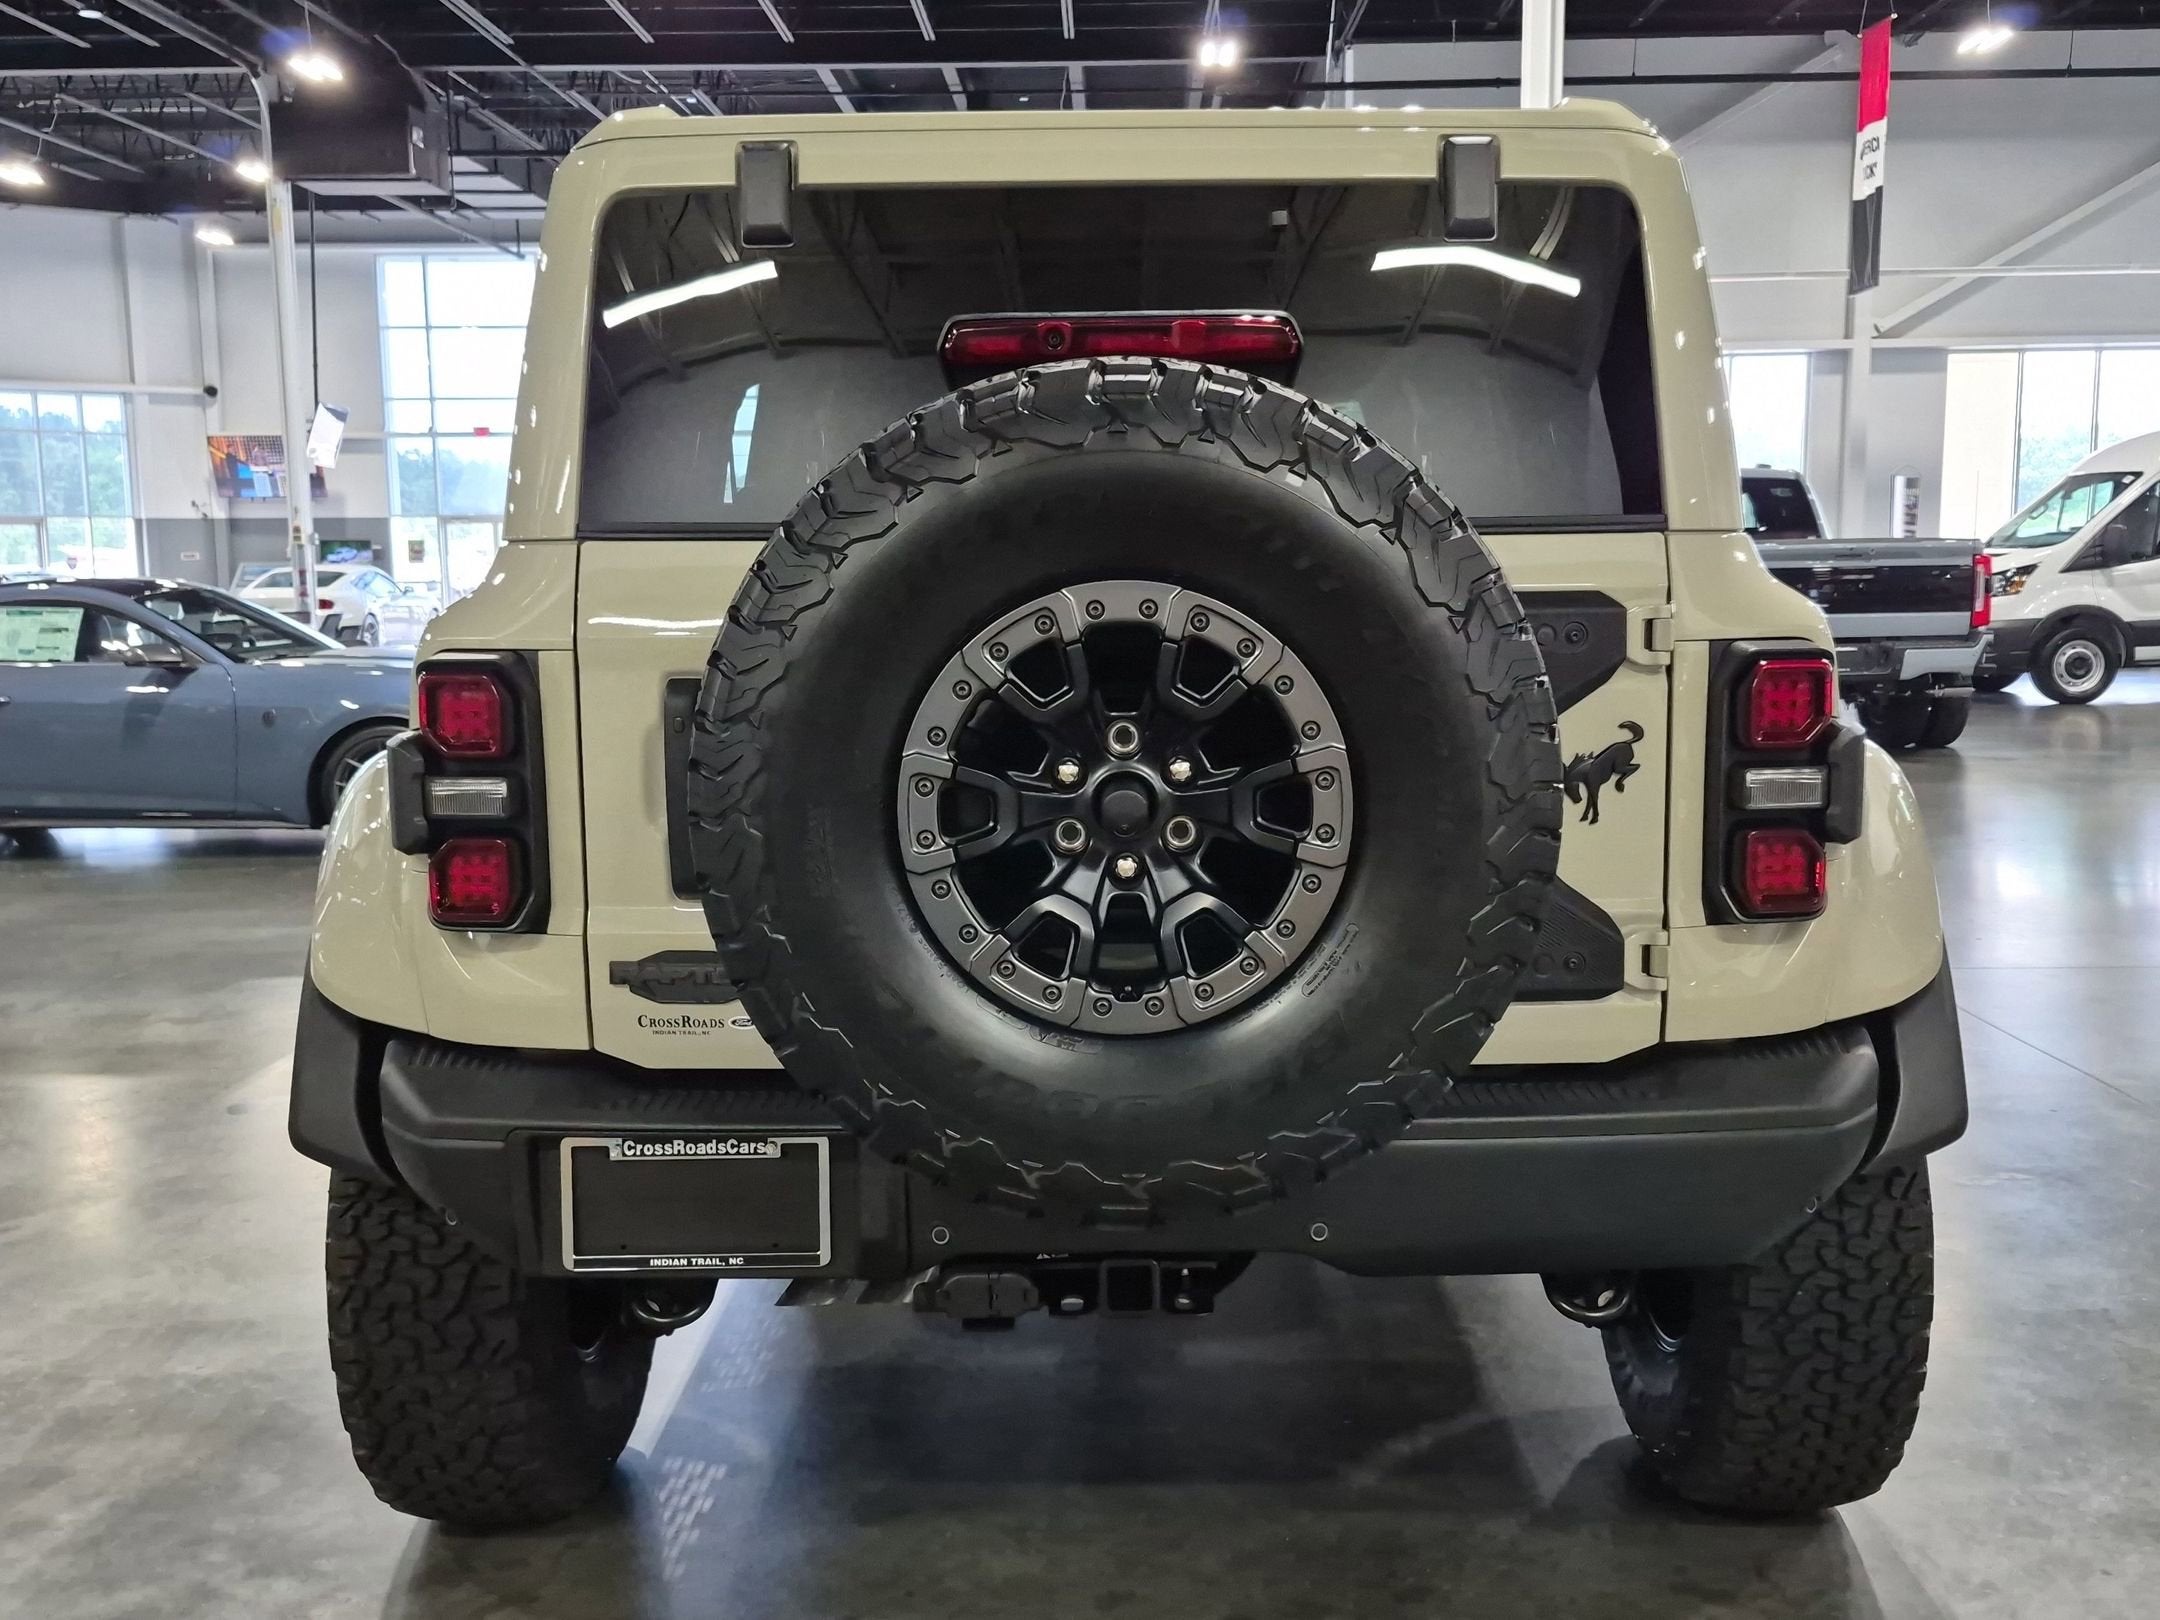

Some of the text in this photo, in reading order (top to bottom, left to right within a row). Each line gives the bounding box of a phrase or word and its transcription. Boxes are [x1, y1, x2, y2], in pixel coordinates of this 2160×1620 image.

[623, 1138, 766, 1156] CrossRoadsCars
[649, 1257, 744, 1267] INDIAN TRAIL, NC
